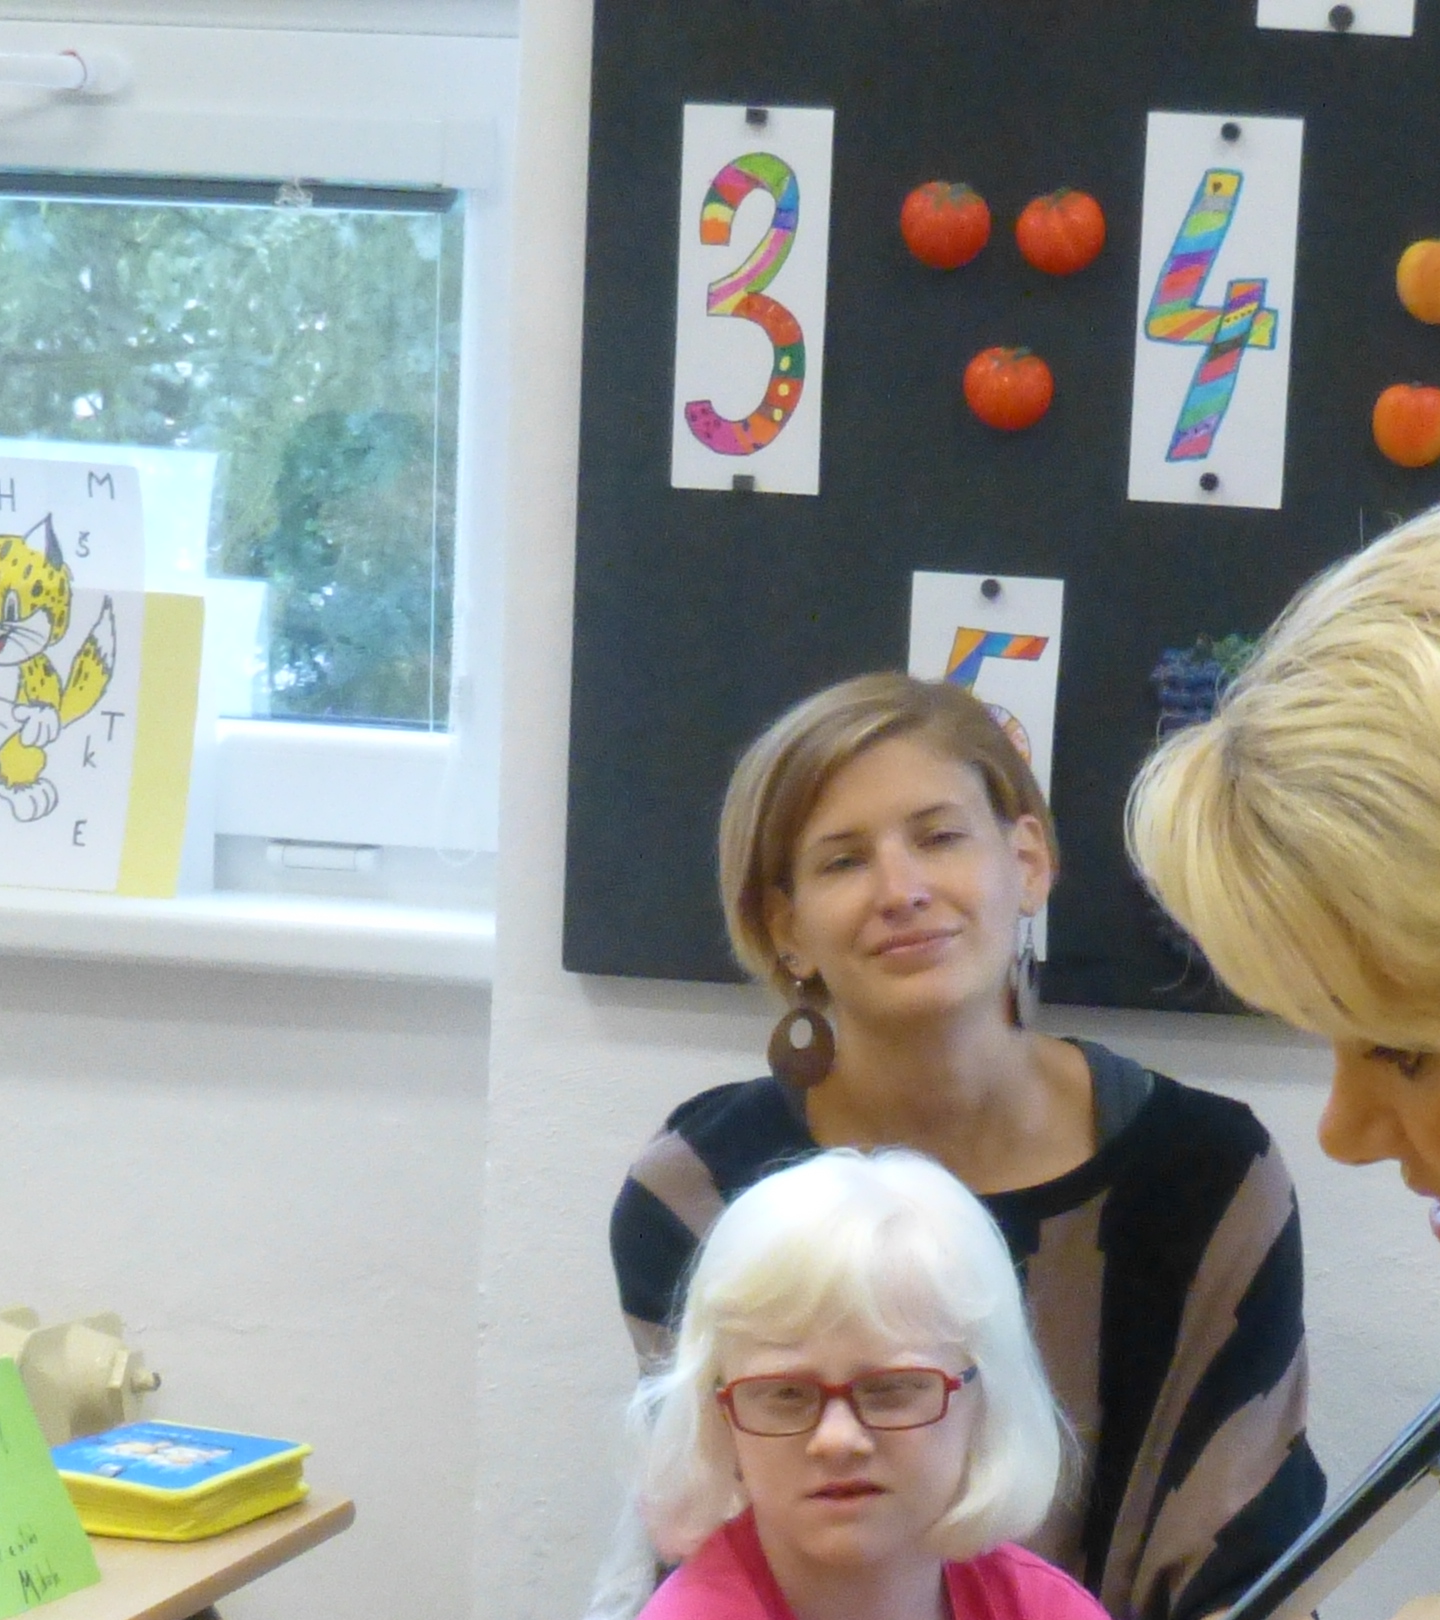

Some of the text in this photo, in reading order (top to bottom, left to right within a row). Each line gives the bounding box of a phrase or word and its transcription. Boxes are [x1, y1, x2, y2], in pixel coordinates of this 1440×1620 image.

[684, 152, 805, 456] 3
[1145, 168, 1278, 463] 4
[87, 471, 115, 499] M
[100, 711, 125, 741] T
[72, 820, 88, 846] E
